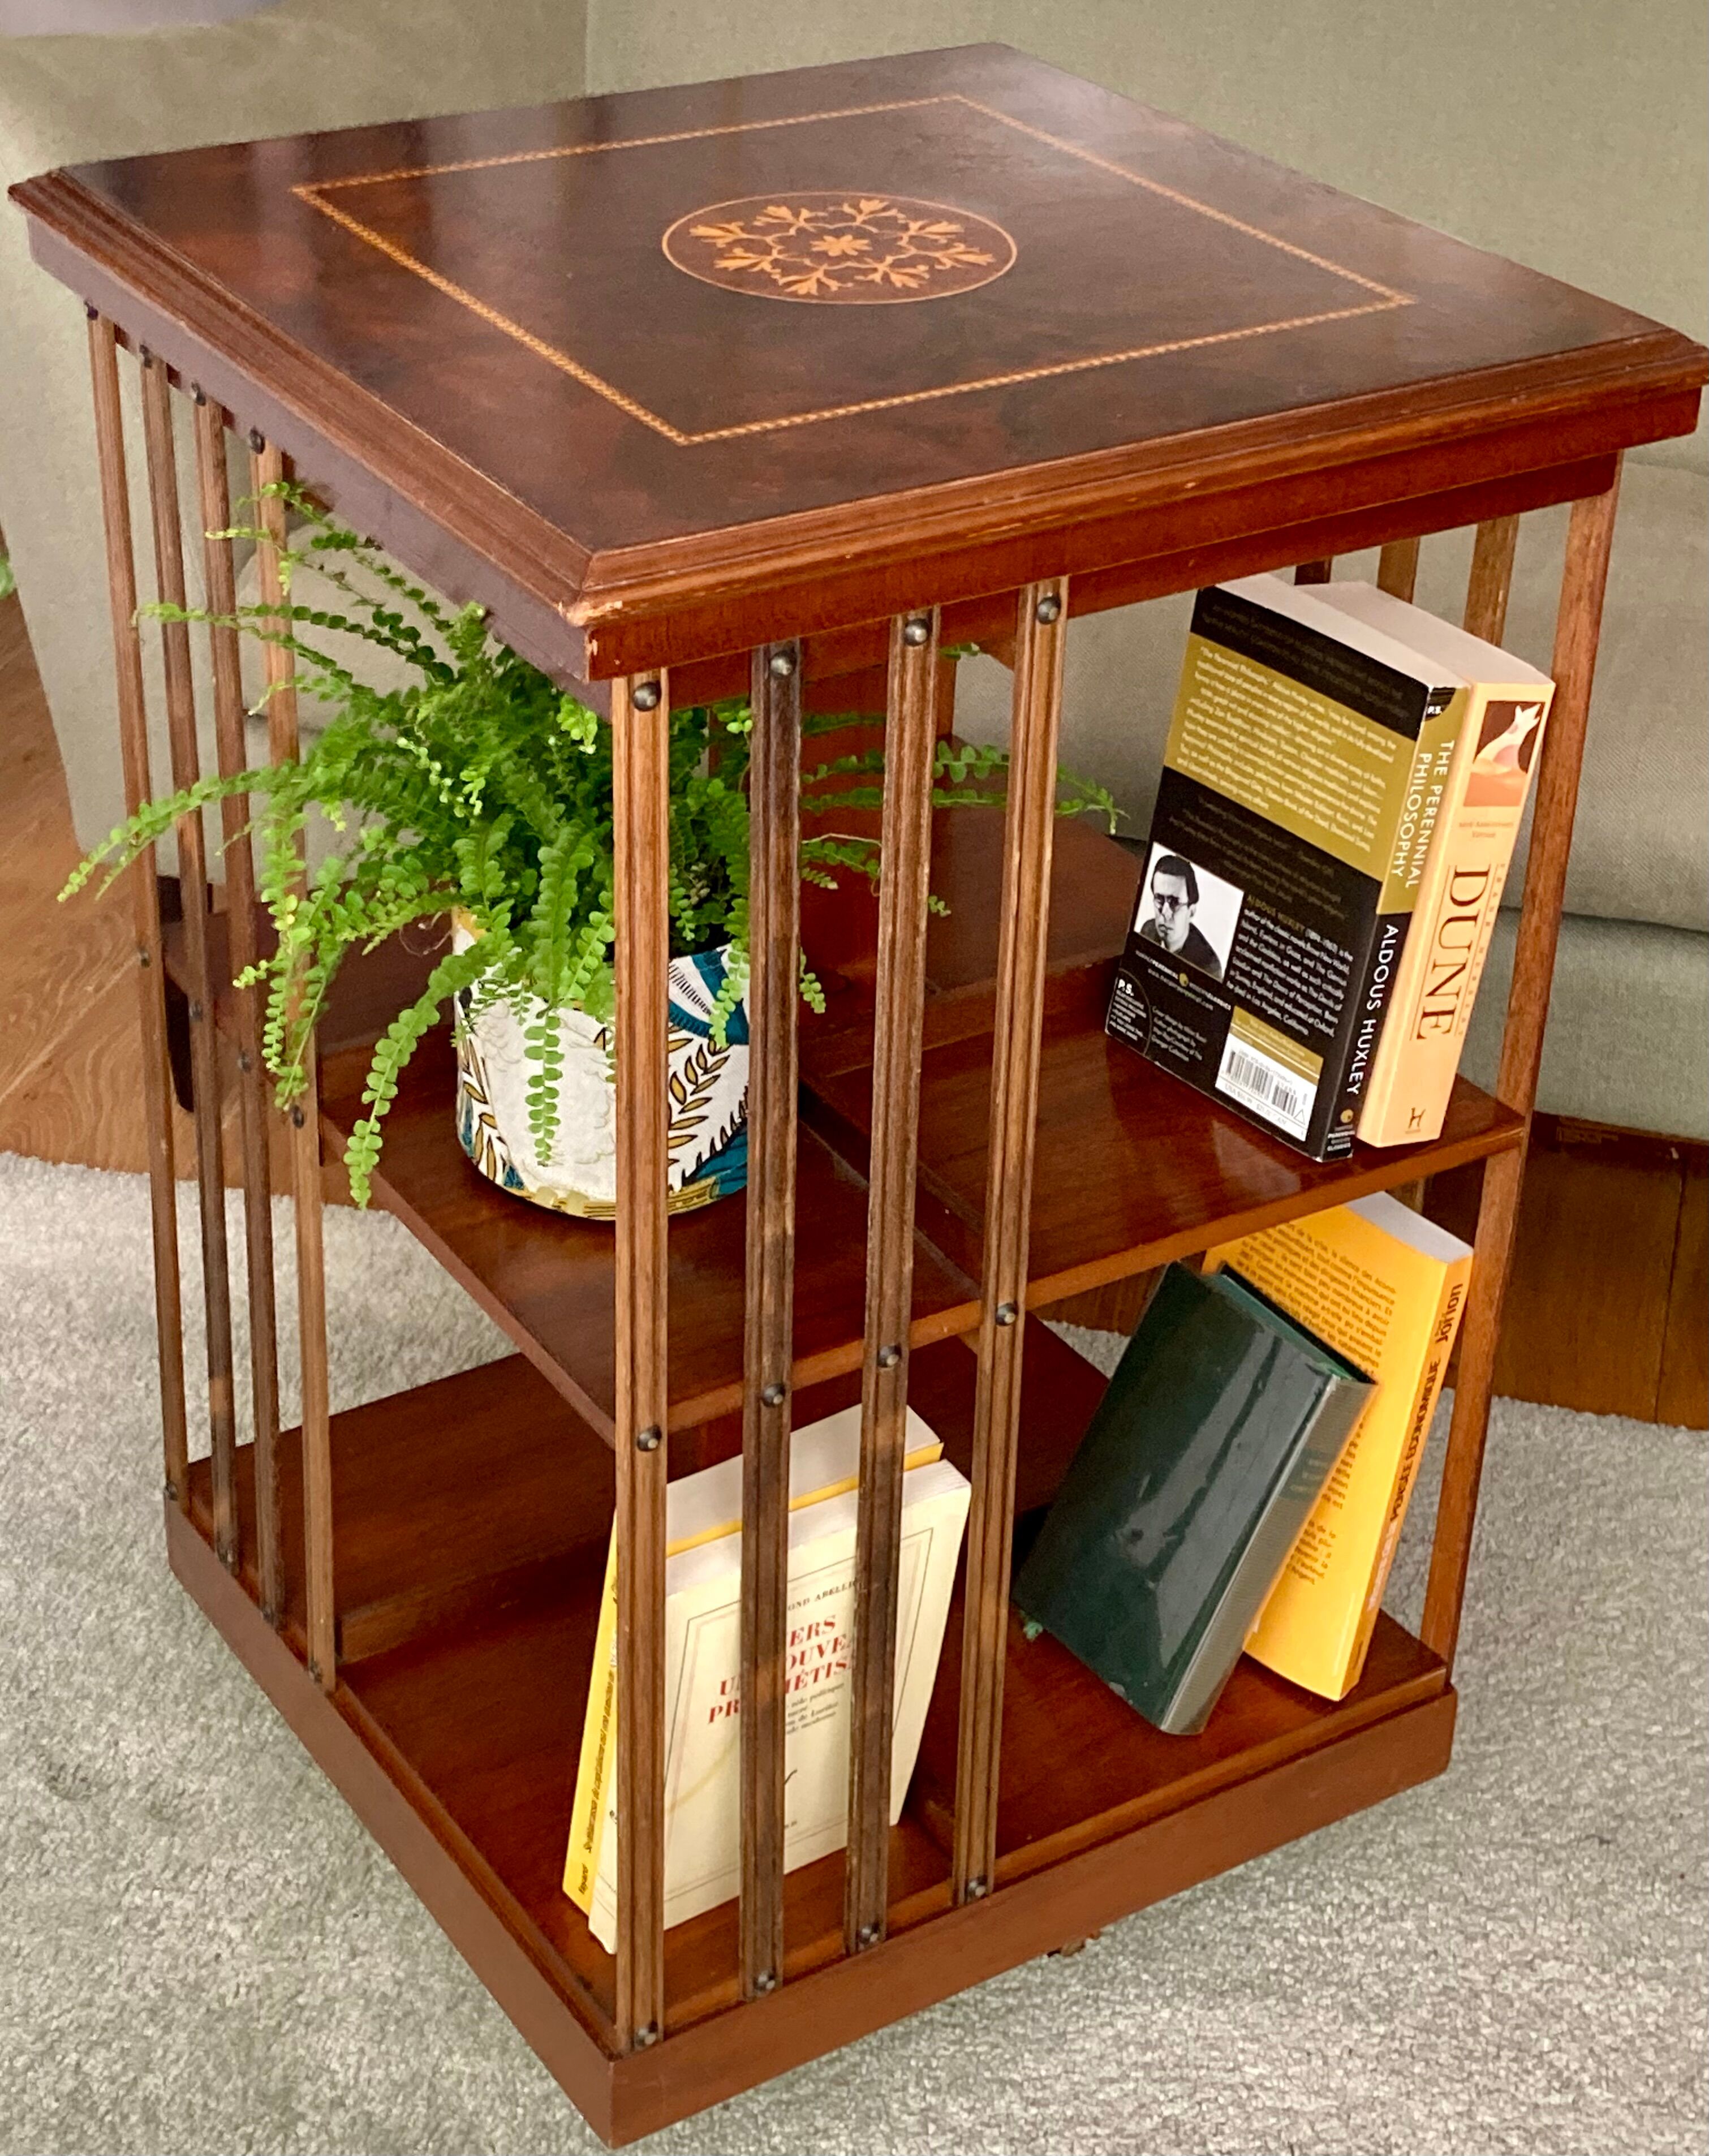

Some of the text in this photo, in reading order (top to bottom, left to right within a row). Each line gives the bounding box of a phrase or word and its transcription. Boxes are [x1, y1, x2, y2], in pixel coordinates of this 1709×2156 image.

[1391, 753, 1432, 877] PHILOSOPHY
[1405, 740, 1455, 888] THE PERENNIAL
[1417, 864, 1491, 1039] DUNE
[1118, 979, 1134, 996] P.S.
[1346, 924, 1398, 1095] ALDOUS HUXLEY
[1435, 1283, 1463, 1344] Jorion
[815, 1580, 856, 1602] ABELLI
[786, 1633, 852, 1669] OUVE
[787, 1615, 836, 1648] ERS
